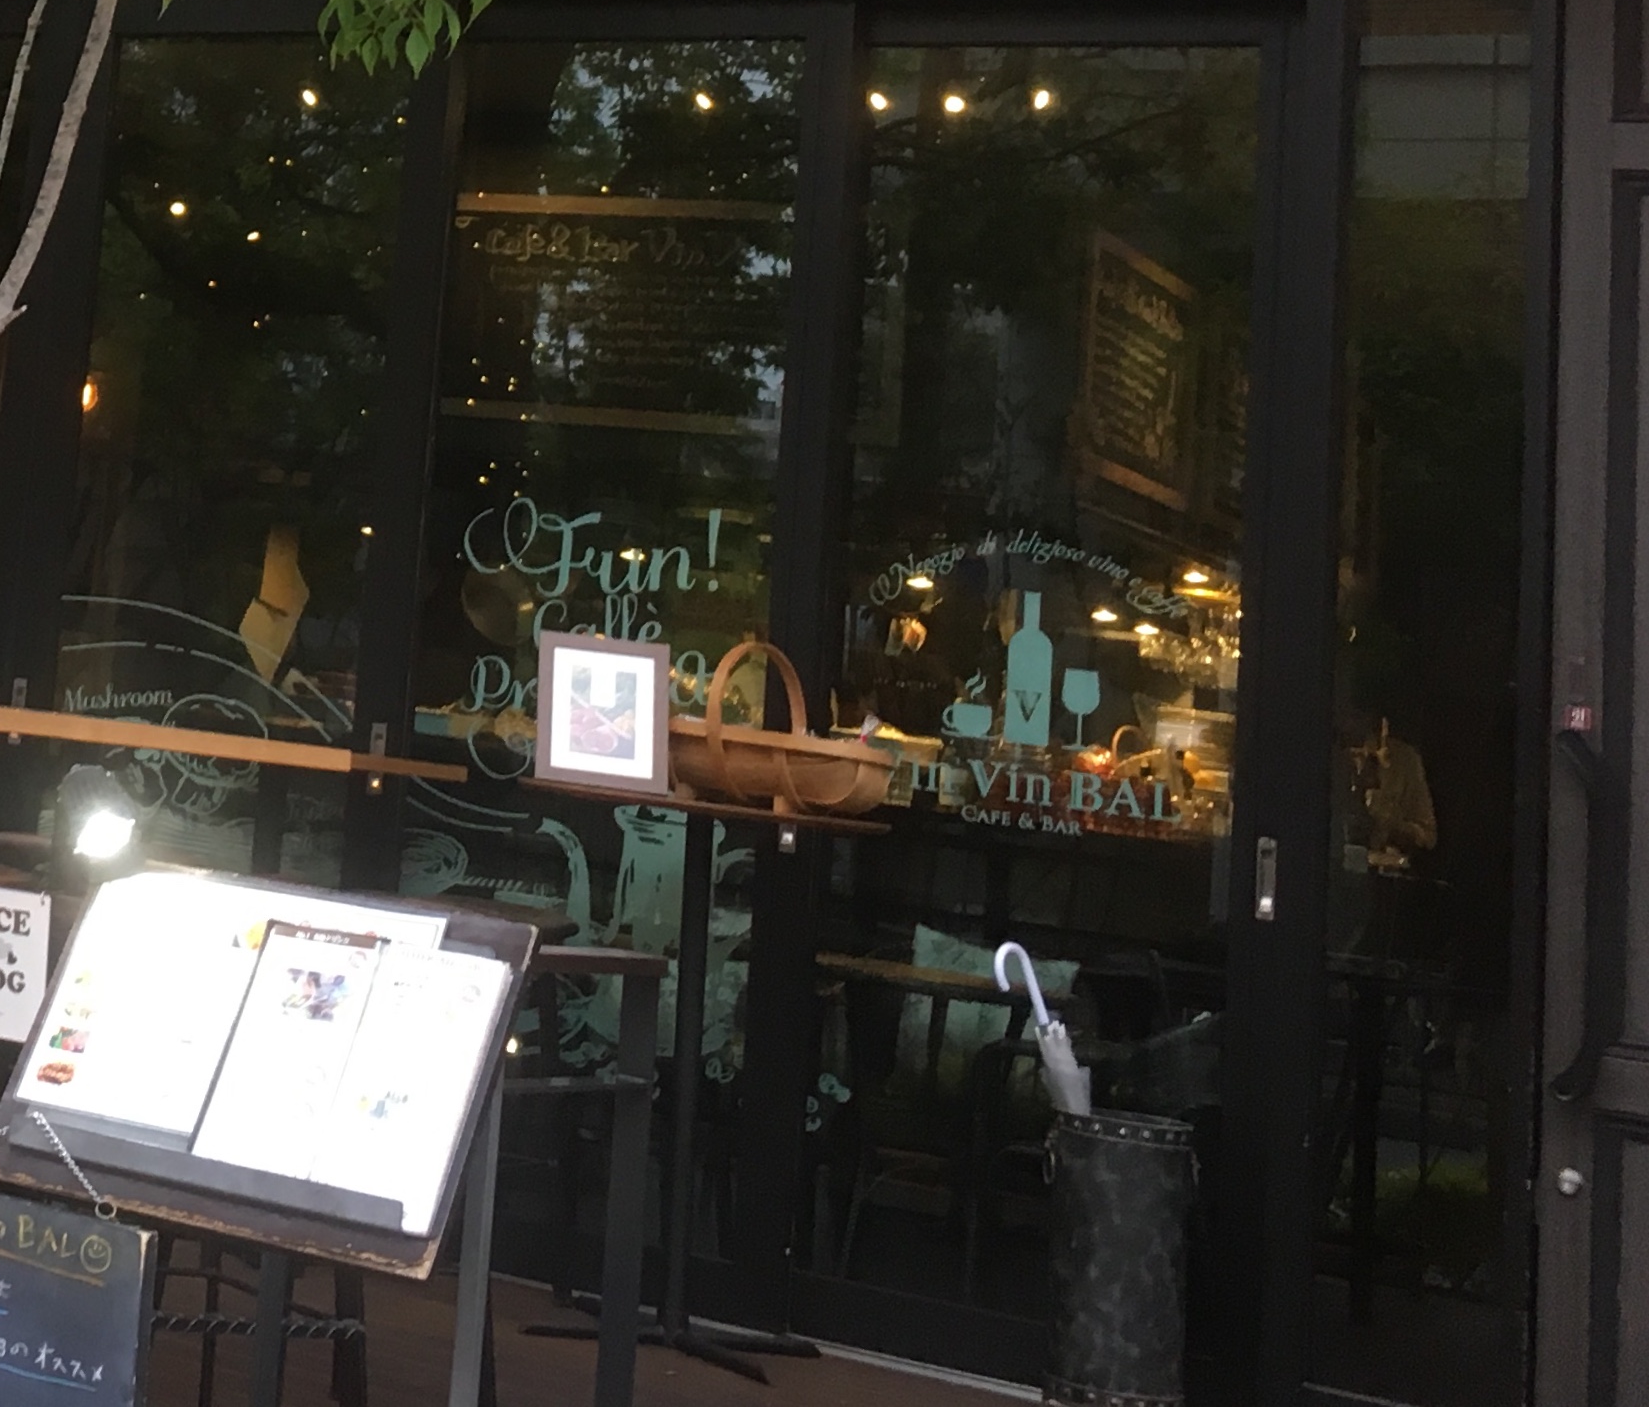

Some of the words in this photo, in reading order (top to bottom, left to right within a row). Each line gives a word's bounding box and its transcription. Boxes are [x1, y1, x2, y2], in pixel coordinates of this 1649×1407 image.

[463, 497, 723, 598] Fun!
[62, 683, 174, 712] Mushroom
[968, 758, 1052, 807] Vin
[1068, 770, 1182, 823] BAL
[961, 804, 1011, 827] CAFE
[1017, 810, 1036, 831] &
[1041, 815, 1083, 837] BAR
[18, 1215, 75, 1259] BAL
